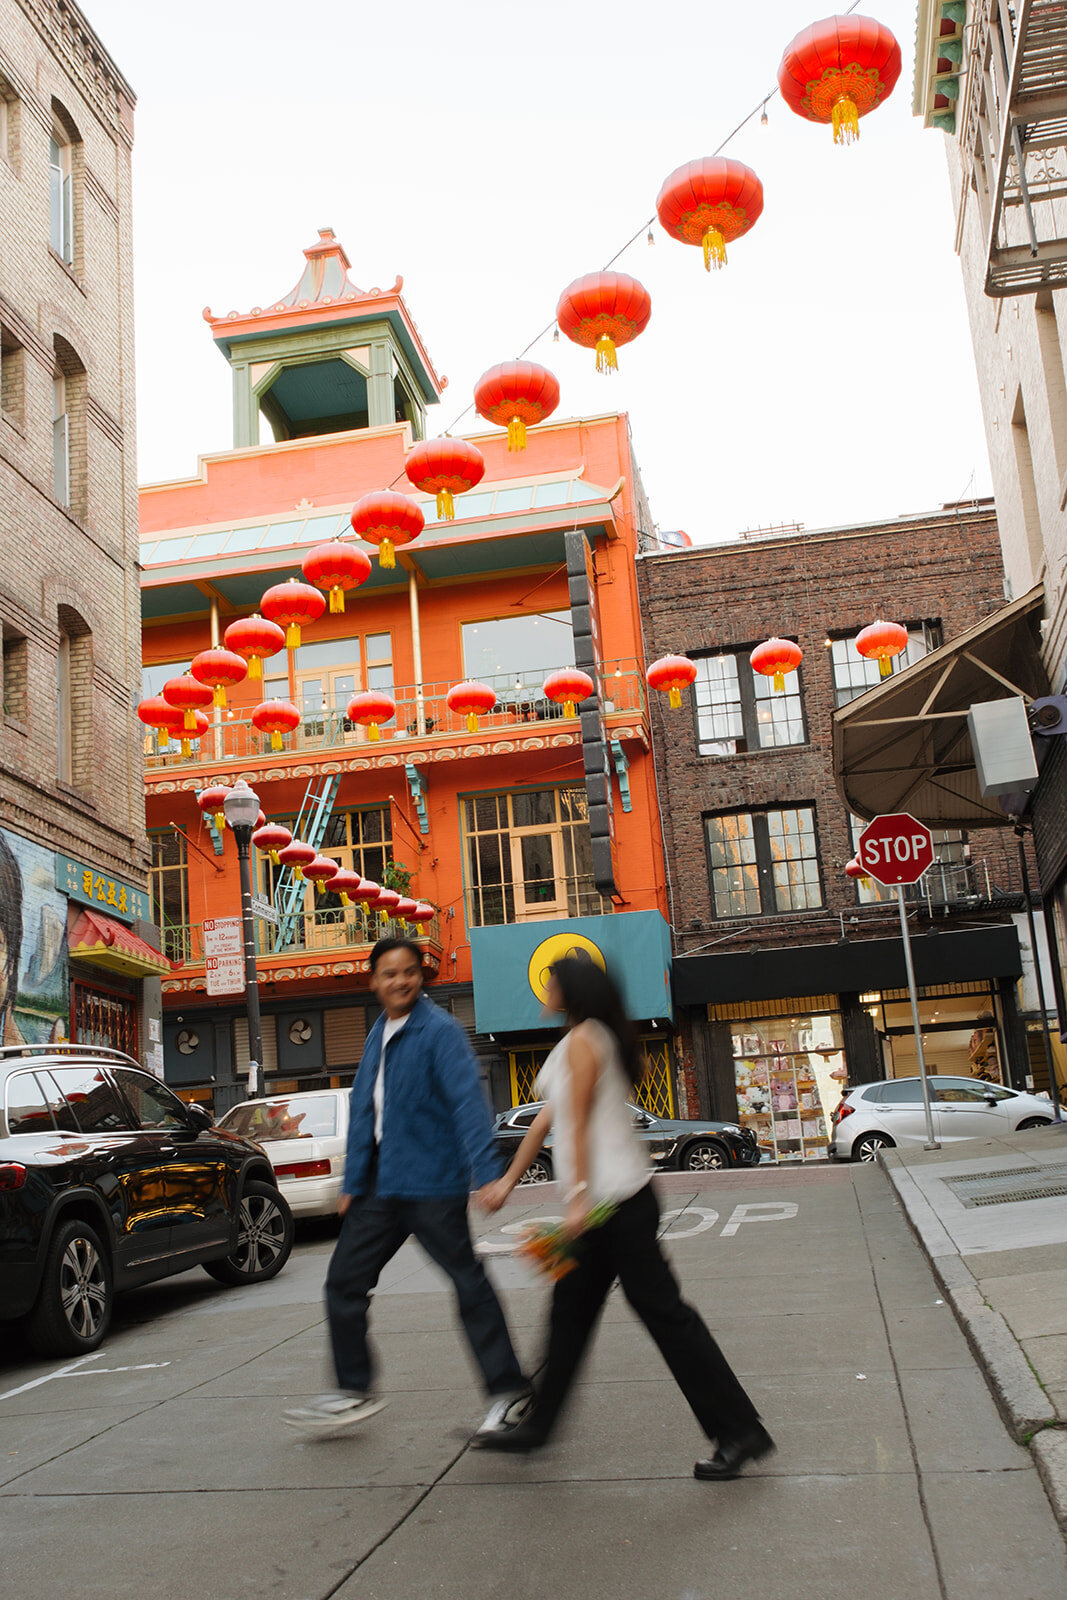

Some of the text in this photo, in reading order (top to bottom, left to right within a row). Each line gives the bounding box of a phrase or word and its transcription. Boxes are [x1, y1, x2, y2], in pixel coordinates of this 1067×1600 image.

[864, 834, 928, 865] STOP
[204, 921, 214, 931] NO
[207, 958, 242, 969] NO PARKING
[474, 1201, 799, 1254] SOP
